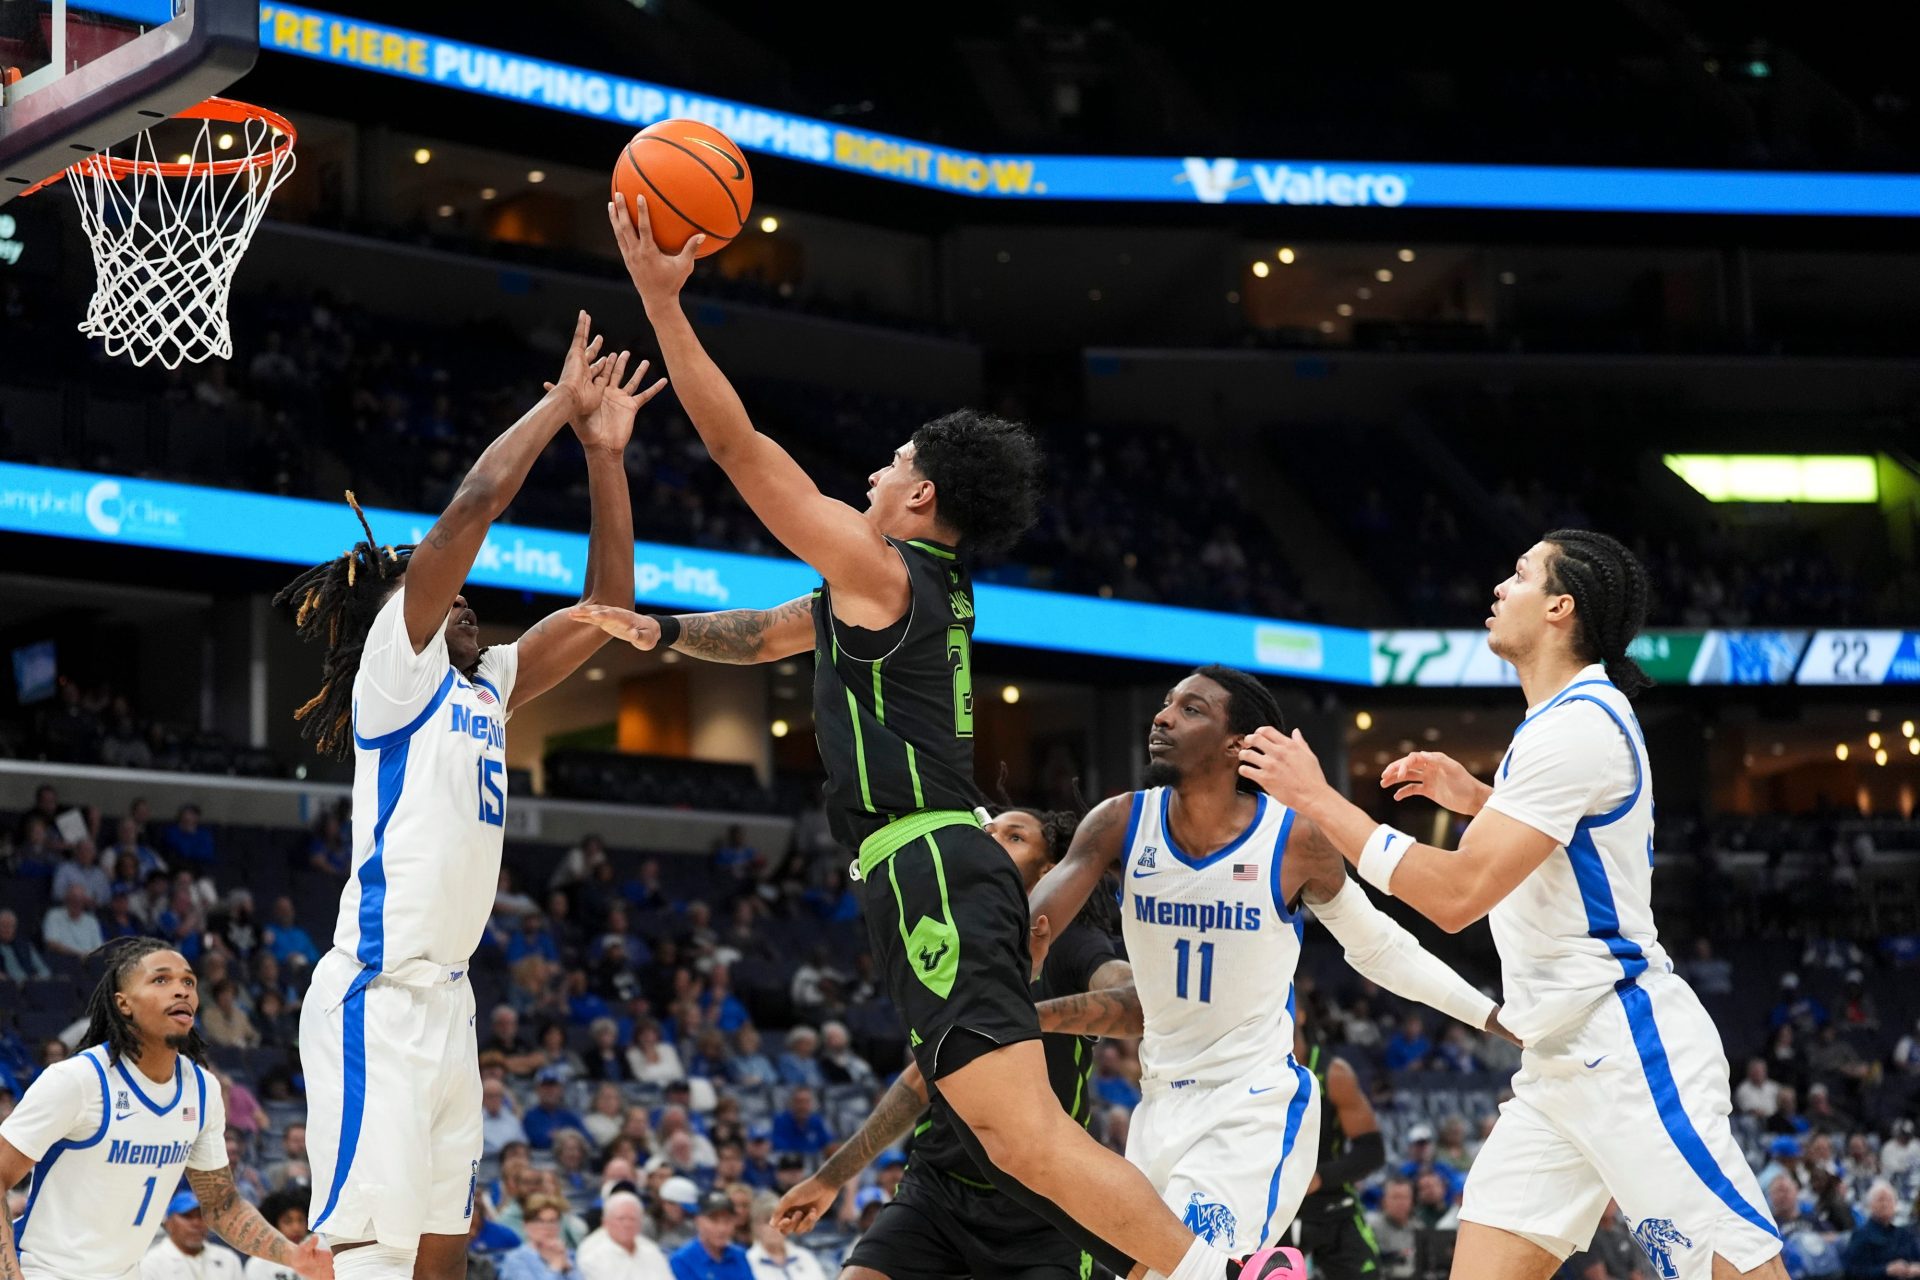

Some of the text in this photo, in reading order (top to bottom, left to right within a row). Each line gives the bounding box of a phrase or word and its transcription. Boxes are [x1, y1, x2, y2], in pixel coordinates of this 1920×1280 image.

[329, 22, 428, 76] HERE
[434, 43, 611, 115] PUMPING
[614, 82, 665, 125] UP
[670, 93, 830, 162] MEMPHIS
[834, 131, 932, 179] RIGHT
[936, 153, 1047, 195] NOW.
[1252, 164, 1406, 207] Valero
[946, 624, 974, 738] 2
[1831, 638, 1869, 679] 22
[477, 755, 505, 828] 15
[1133, 893, 1261, 934] Memphis
[1174, 938, 1215, 1004] 11
[133, 1176, 157, 1227] 1
